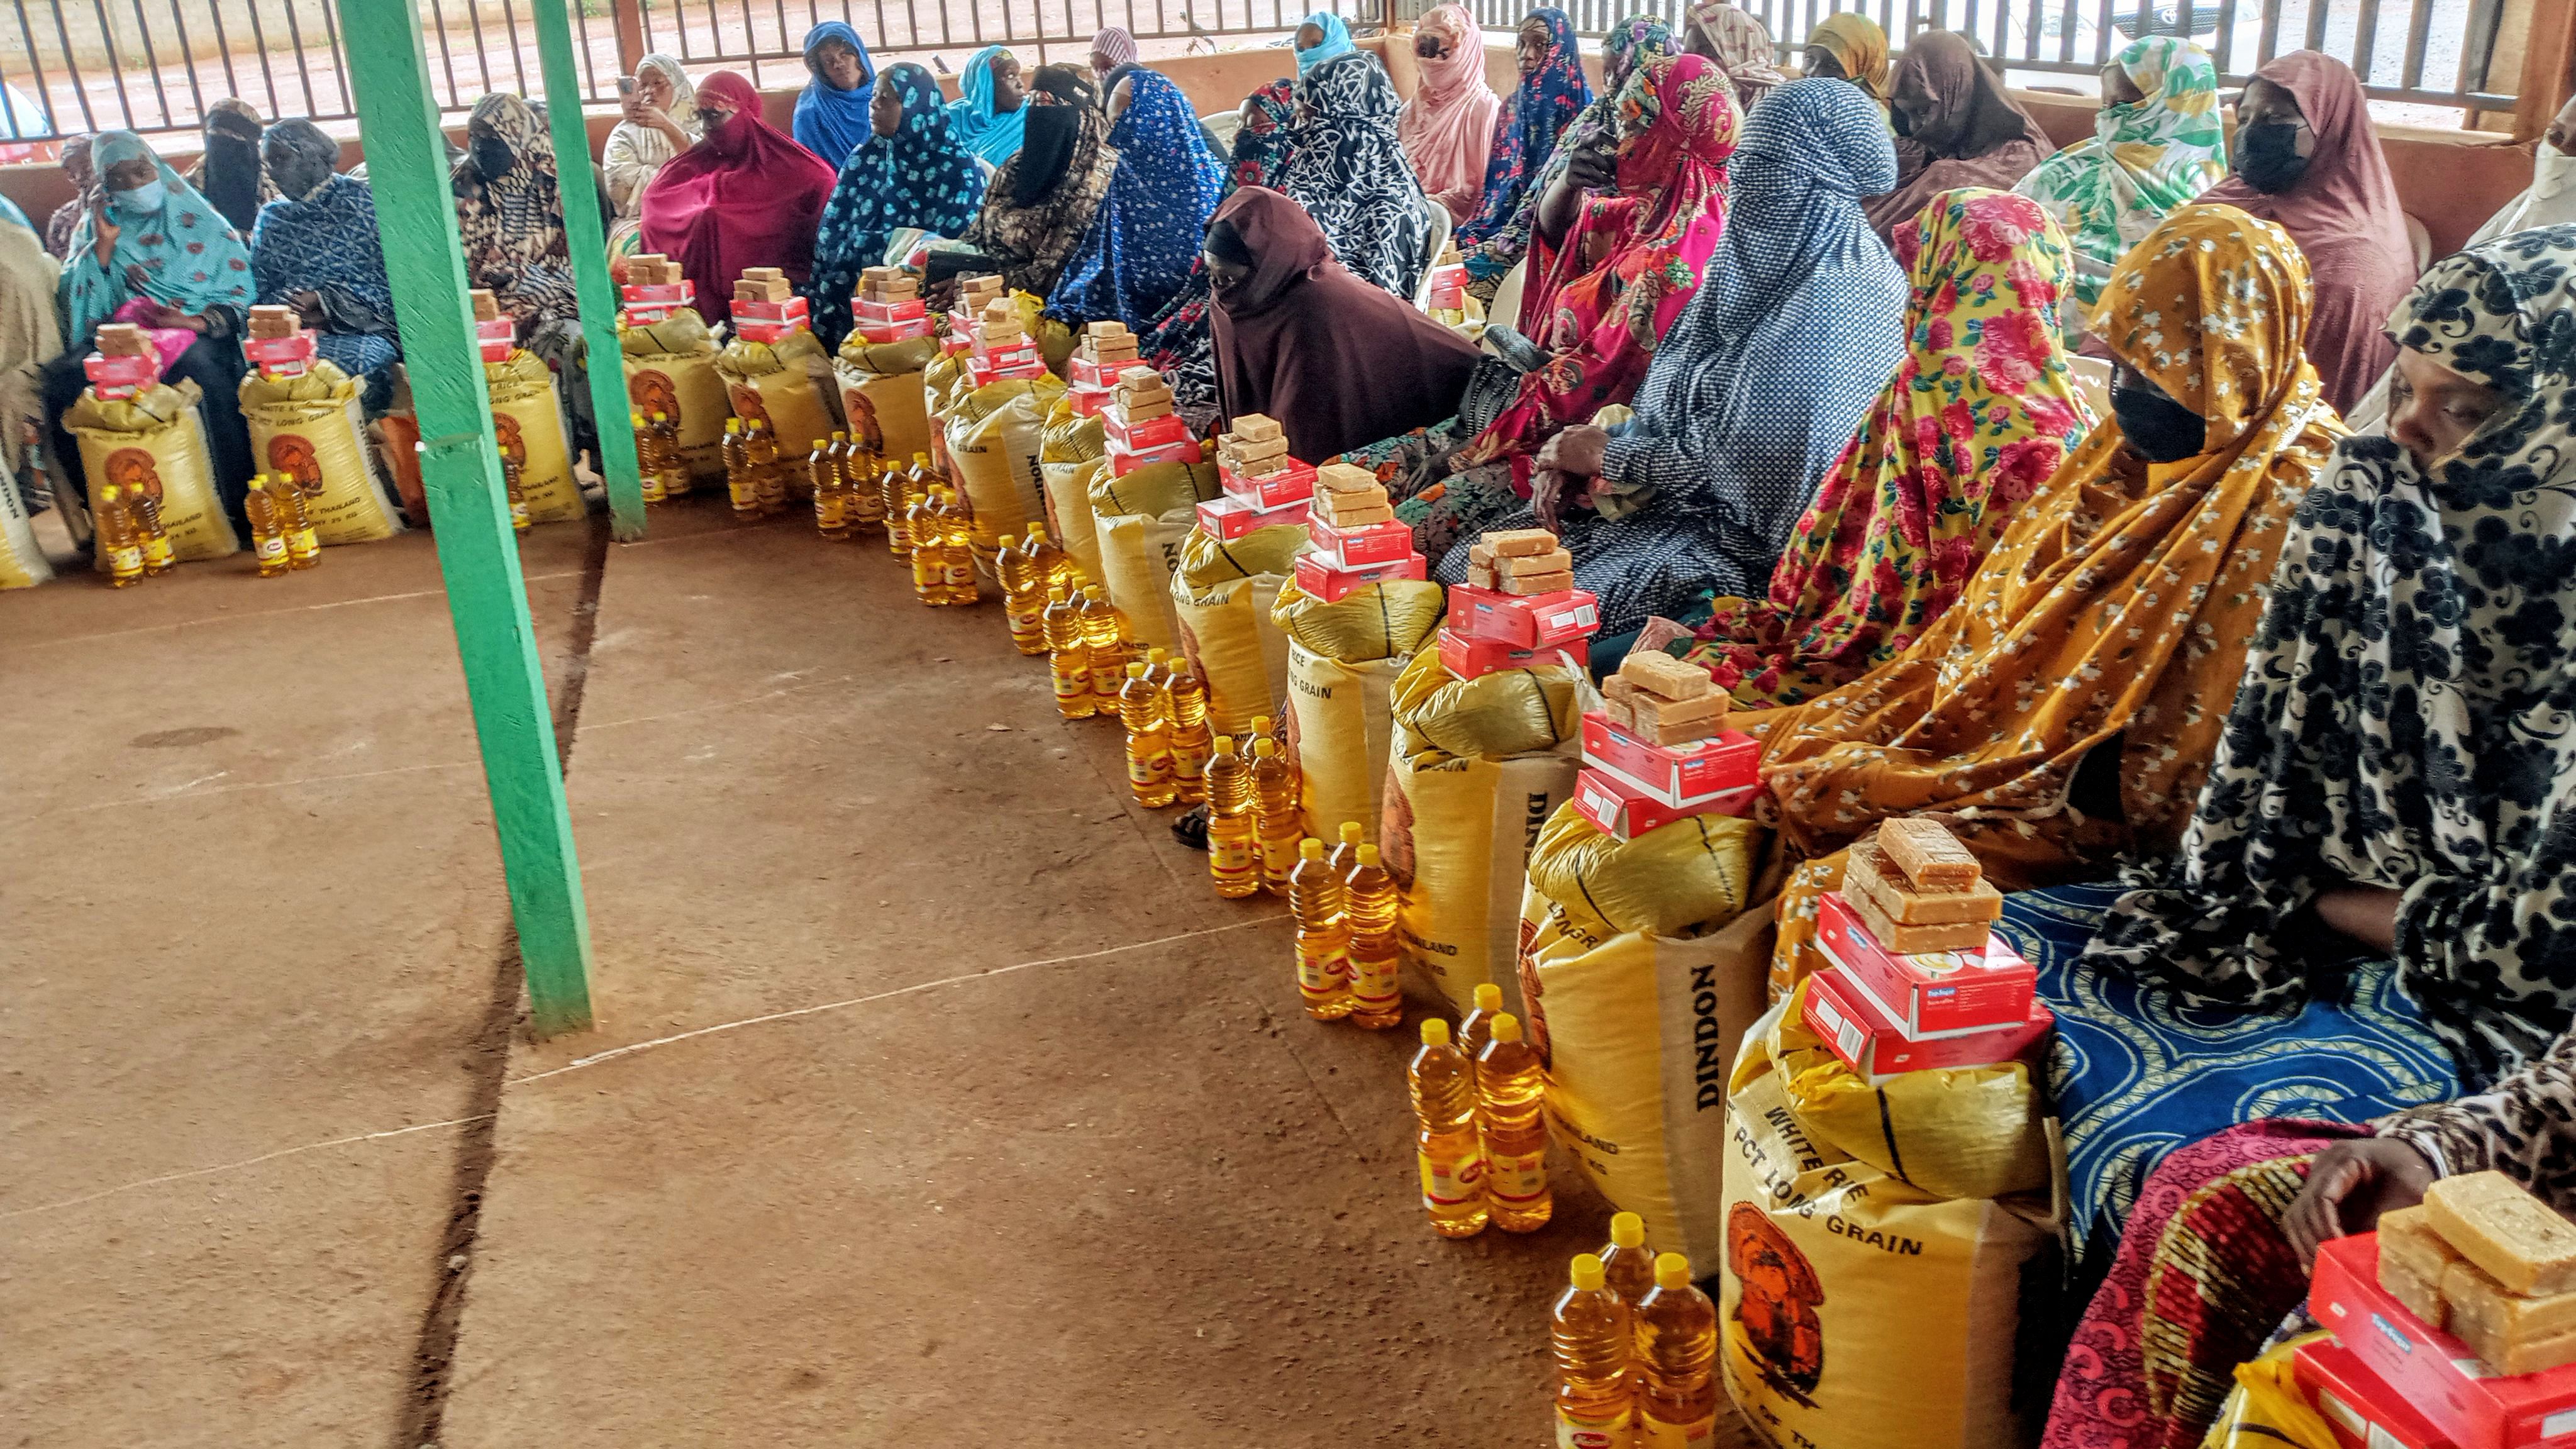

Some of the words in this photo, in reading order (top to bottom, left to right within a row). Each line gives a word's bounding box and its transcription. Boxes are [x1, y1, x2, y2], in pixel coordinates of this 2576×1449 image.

[957, 444, 987, 453] GRAIN
[1026, 455, 1047, 515] NDON
[1171, 589, 1191, 605] LONG
[1194, 594, 1229, 607] GRAIN
[1292, 648, 1305, 667] RICE
[1289, 667, 1297, 686] NG
[1299, 680, 1332, 699] GRAIN
[1690, 965, 1719, 1112] DINDON
[1764, 1106, 1824, 1172] WHITE
[1734, 1127, 1767, 1168] PCT
[1764, 1168, 1816, 1220] LONG
[1826, 1214, 1923, 1255] GRAIN
